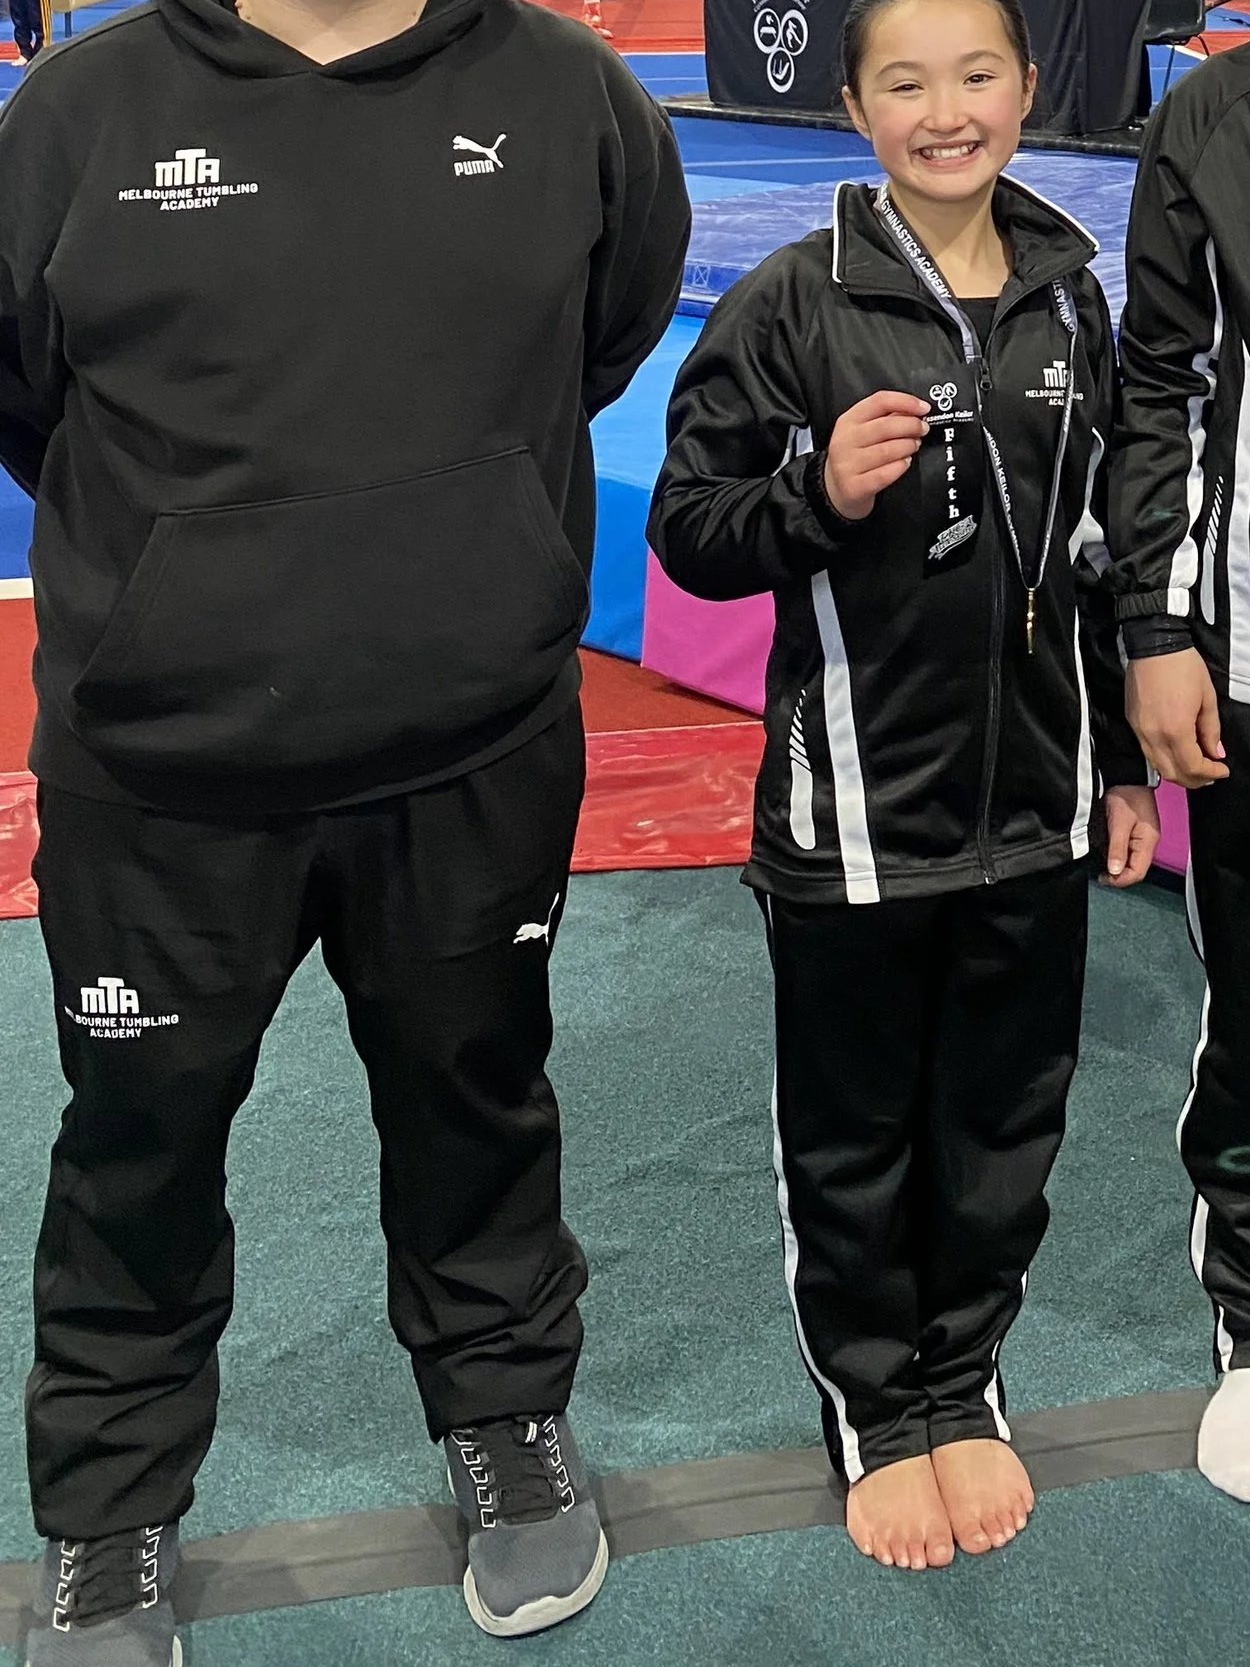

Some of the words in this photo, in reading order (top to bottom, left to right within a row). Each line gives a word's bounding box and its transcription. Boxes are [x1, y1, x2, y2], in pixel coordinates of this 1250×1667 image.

[453, 159, 495, 176] PUMA
[118, 188, 193, 201] MELBOURNE
[195, 183, 259, 197] TUMBLING
[160, 197, 219, 211] ACADEMY
[881, 200, 921, 258] GYMNASTICS
[914, 256, 952, 299] ACADEMY
[1052, 279, 1076, 332] GYMNASTI
[70, 1011, 117, 1027] BOURNE
[119, 1014, 179, 1028] TUMBLING
[90, 1028, 142, 1038] ACADEMY
